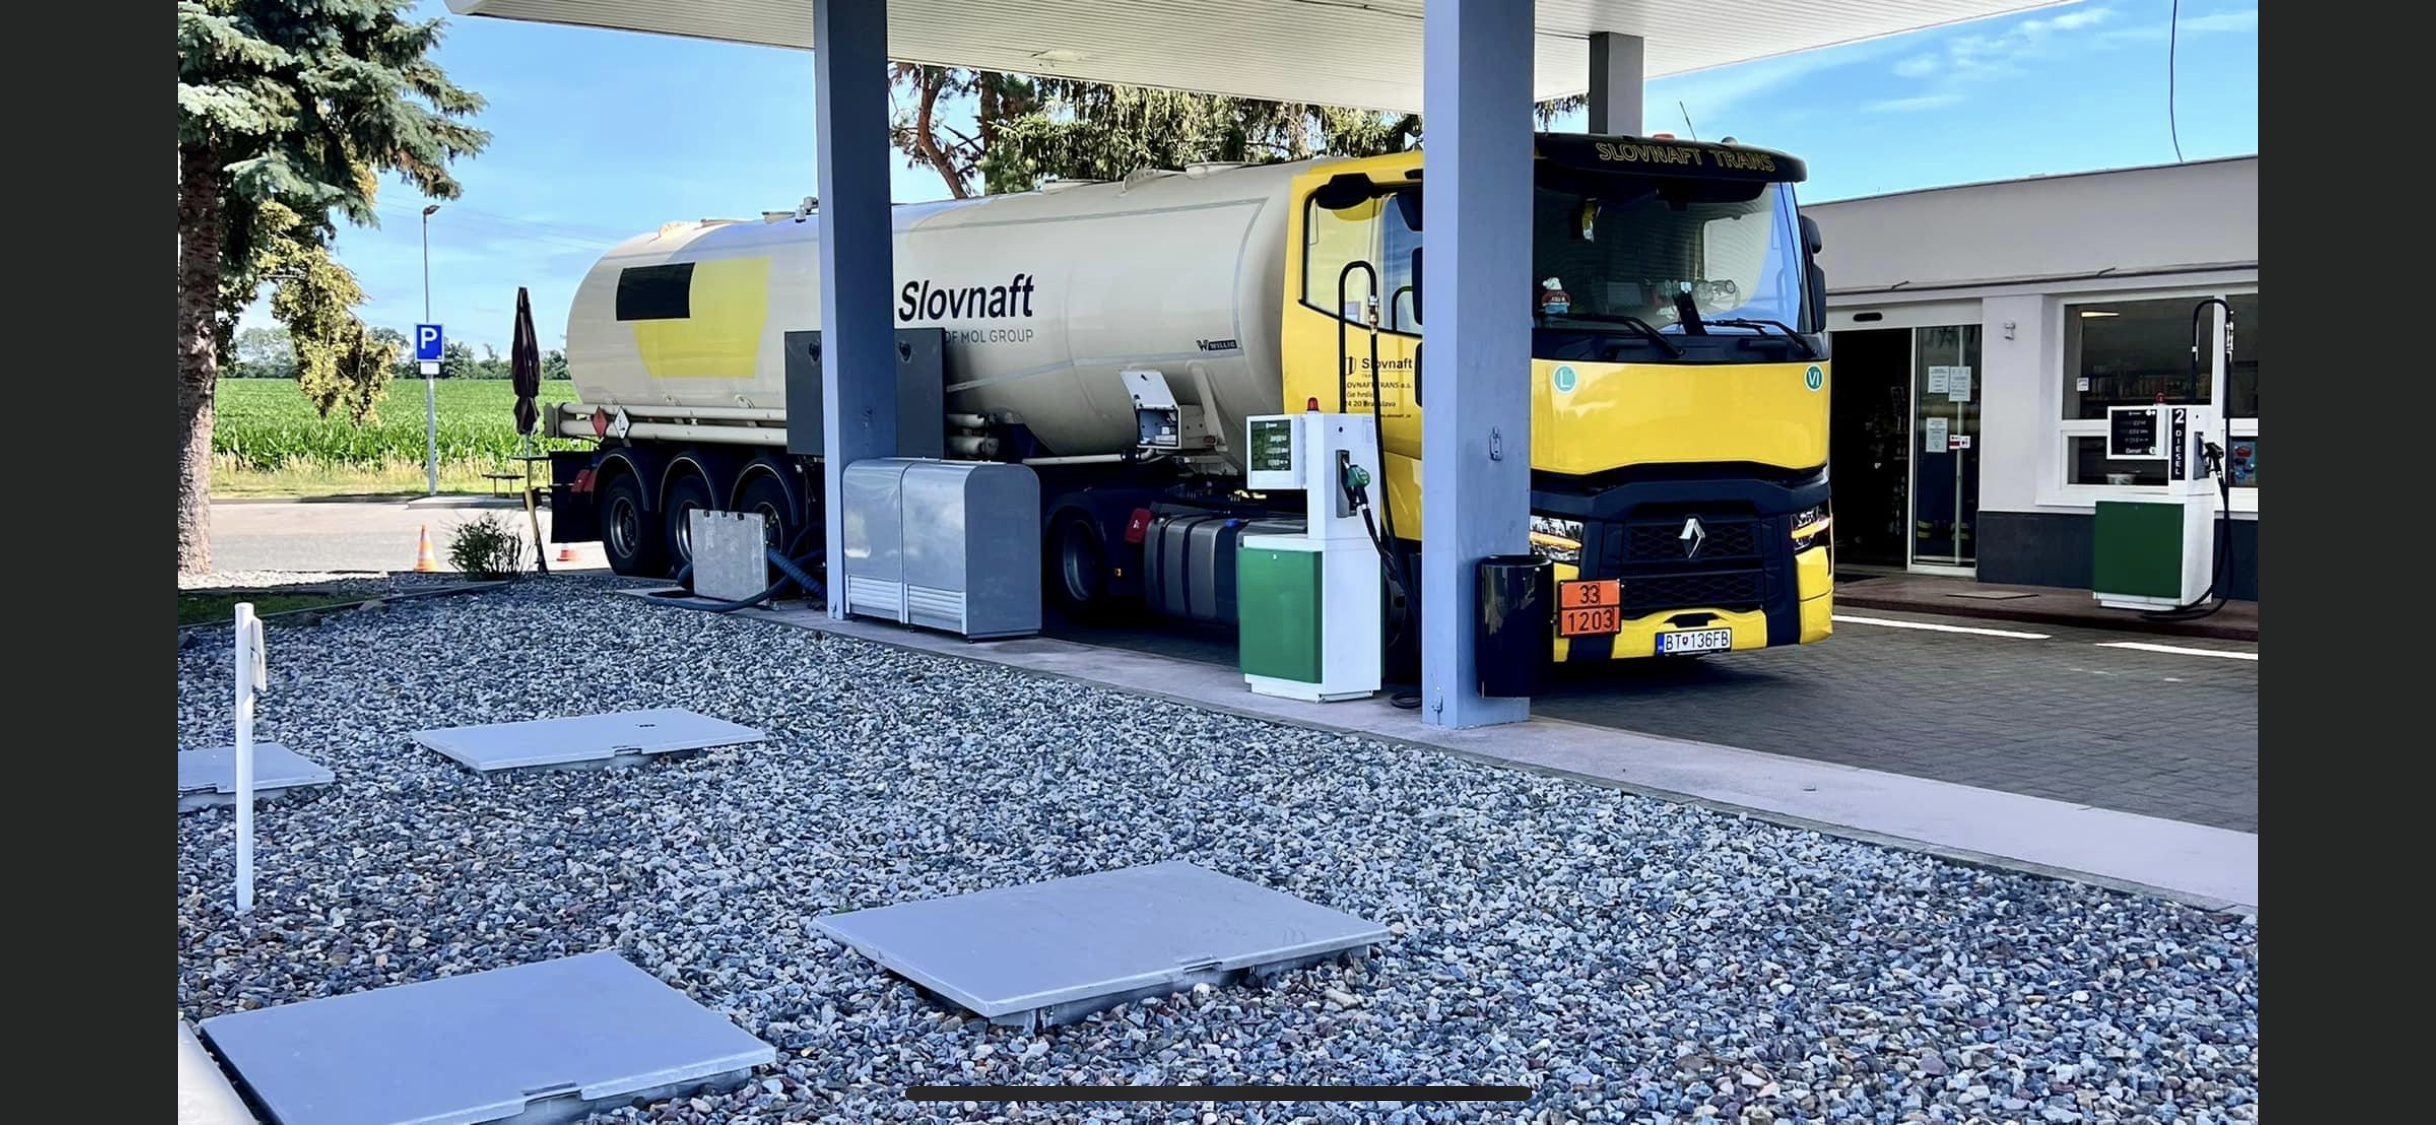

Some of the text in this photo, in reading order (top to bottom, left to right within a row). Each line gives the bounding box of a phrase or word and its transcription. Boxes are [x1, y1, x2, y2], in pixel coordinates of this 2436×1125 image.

[1596, 142, 1775, 172] SLOVNAFT TRANS
[898, 273, 1034, 322] Slovnaft
[421, 327, 437, 350] P
[961, 330, 986, 343] MOL
[989, 329, 1033, 343] GROUP
[1362, 358, 1412, 369] Sovnaft
[1560, 370, 1571, 388] L
[1808, 371, 1820, 386] VI
[2174, 409, 2185, 424] 2
[2175, 429, 2183, 475] DIESEL
[1580, 585, 1600, 604] 33
[1568, 608, 1614, 632] 1203
[1692, 633, 1729, 649] 136FB
